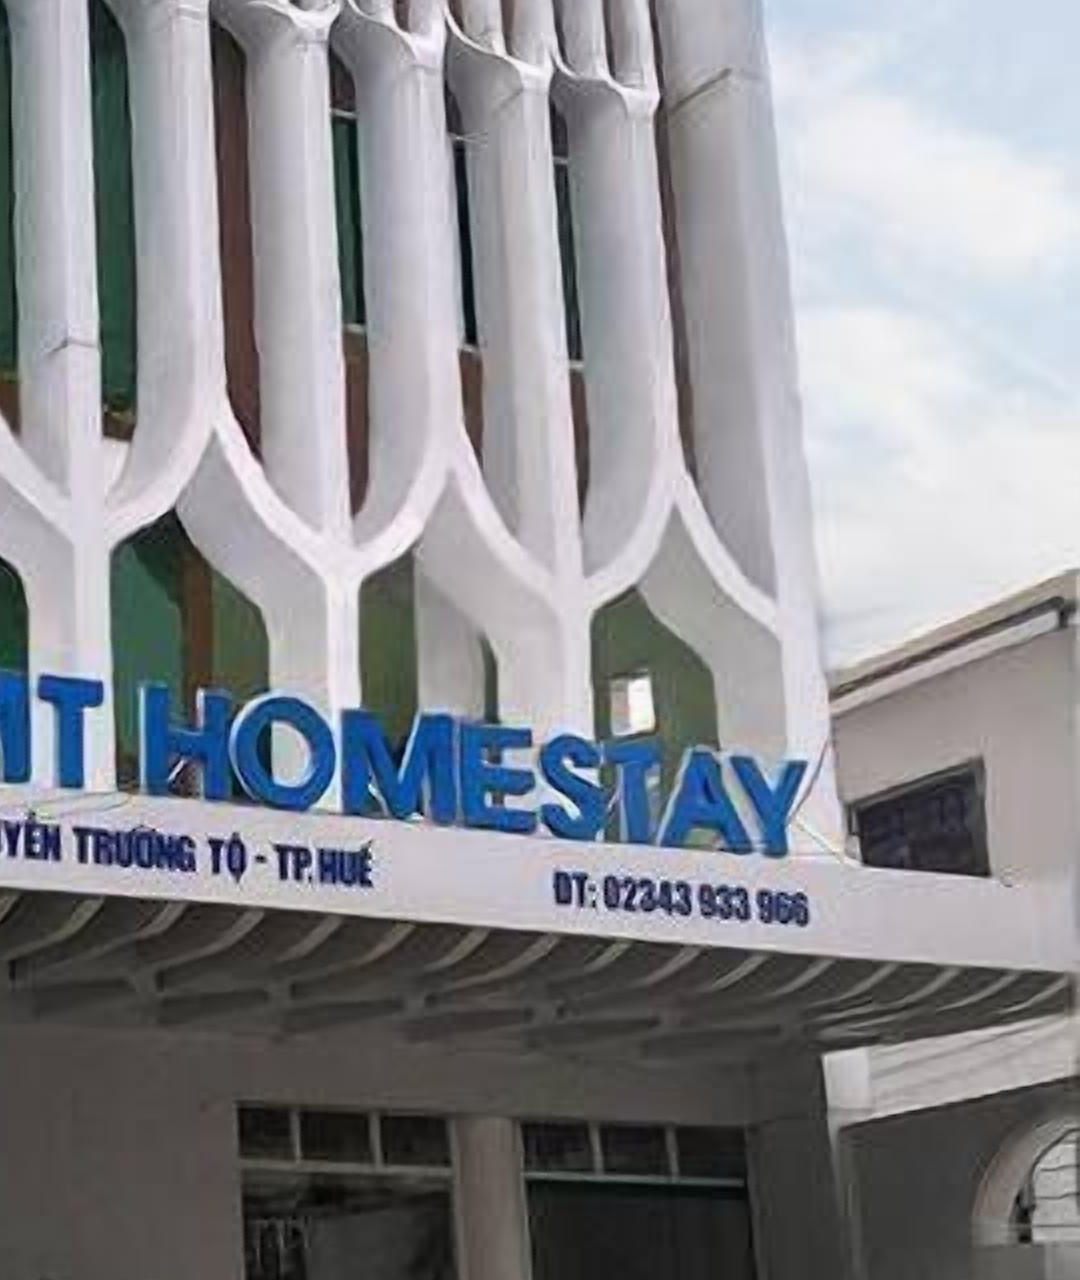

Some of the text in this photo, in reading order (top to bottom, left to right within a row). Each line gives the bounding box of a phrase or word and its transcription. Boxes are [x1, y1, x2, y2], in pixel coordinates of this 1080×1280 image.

[139, 683, 810, 858] HOMESTAY
[604, 875, 691, 916] 02343
[698, 883, 751, 921] 933
[756, 887, 810, 926] 966
